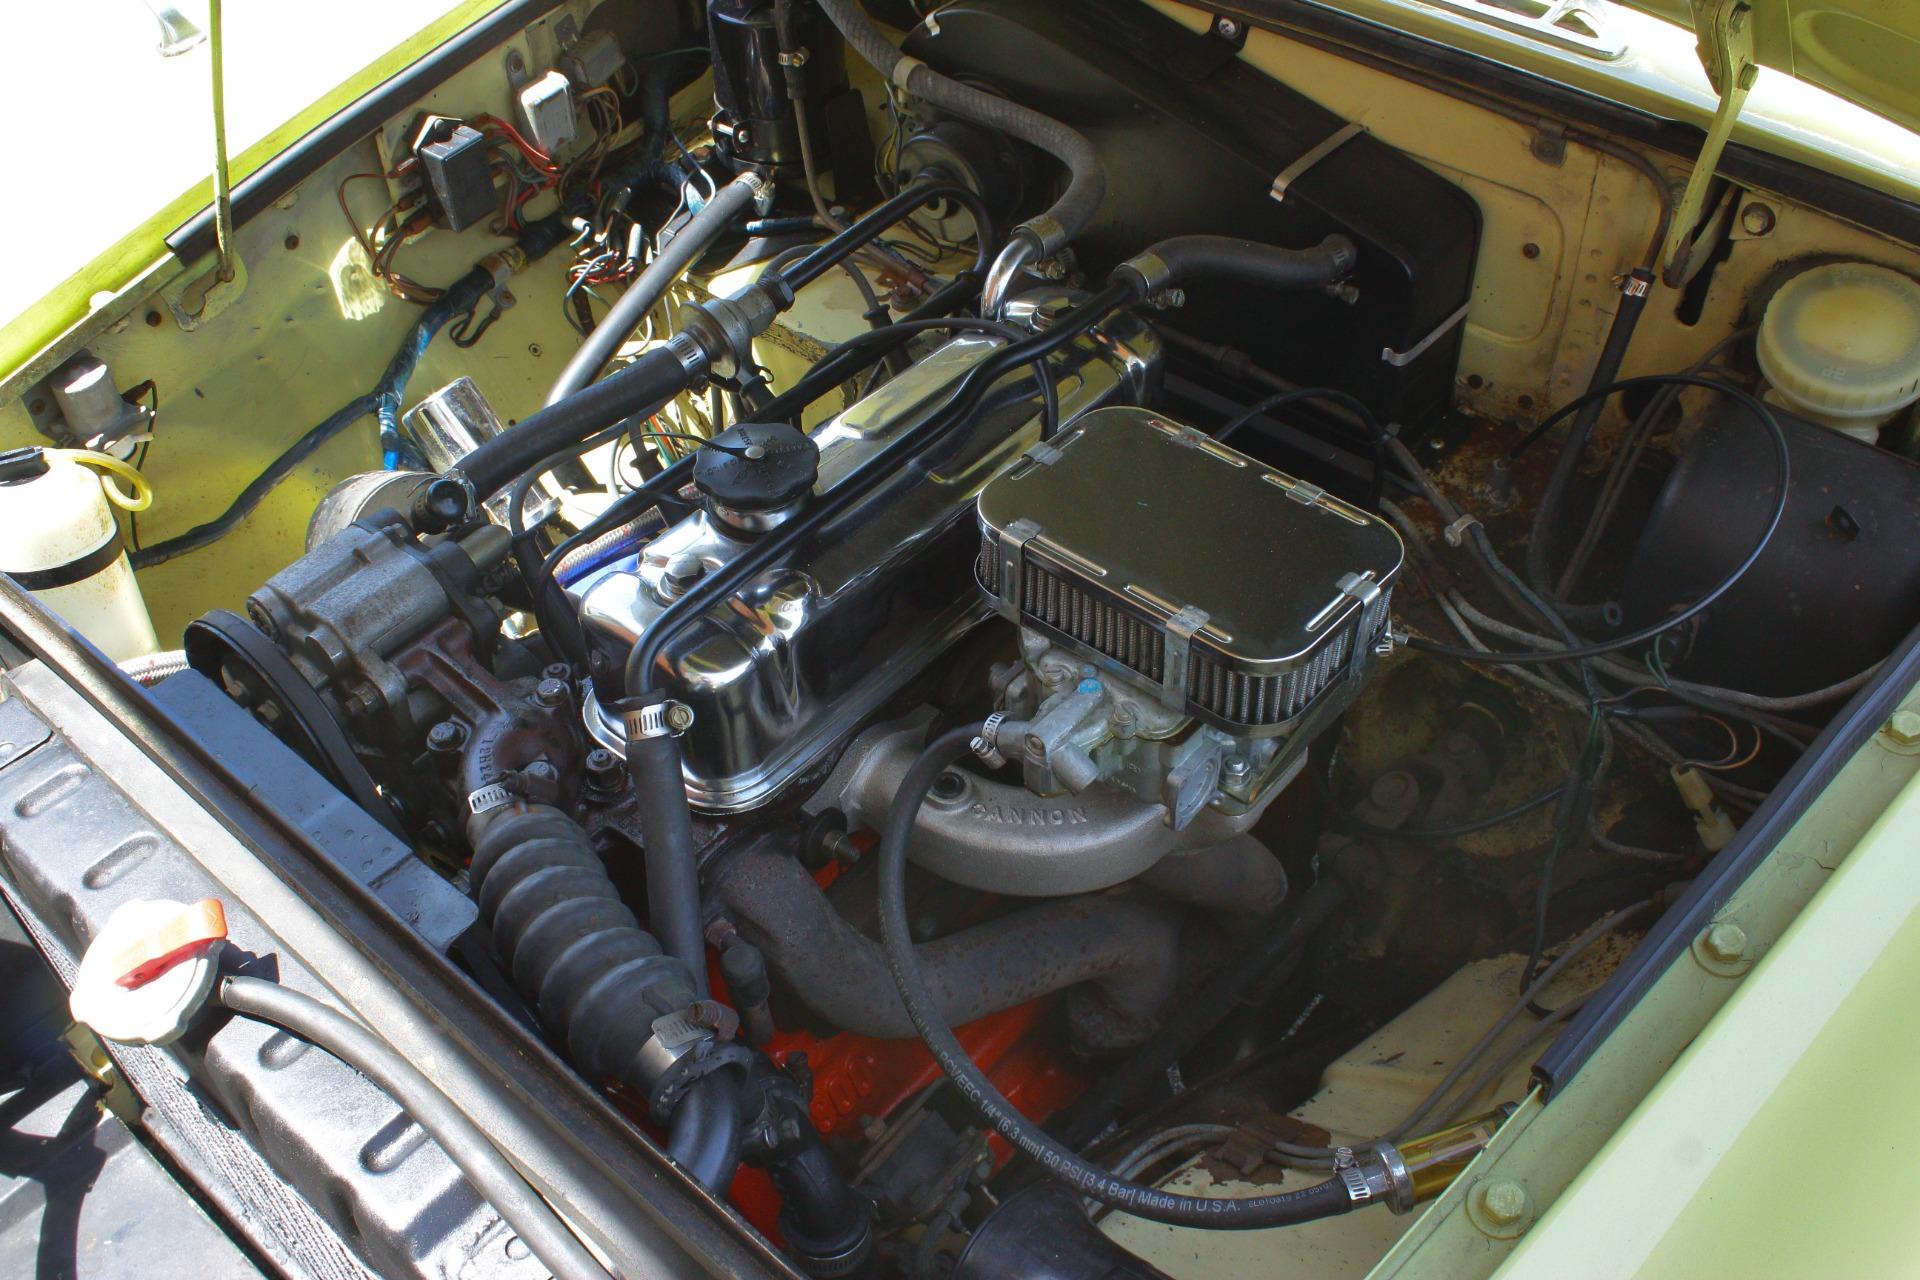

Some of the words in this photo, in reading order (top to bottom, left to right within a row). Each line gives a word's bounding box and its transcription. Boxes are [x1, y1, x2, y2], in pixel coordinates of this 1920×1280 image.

[971, 803, 1088, 826] CANNON
[1043, 1151, 1060, 1168] 50
[1060, 1161, 1083, 1181] PSI
[1137, 1191, 1176, 1210] Made
[1179, 1198, 1192, 1211] in
[1196, 1199, 1241, 1213] U.S.A.
